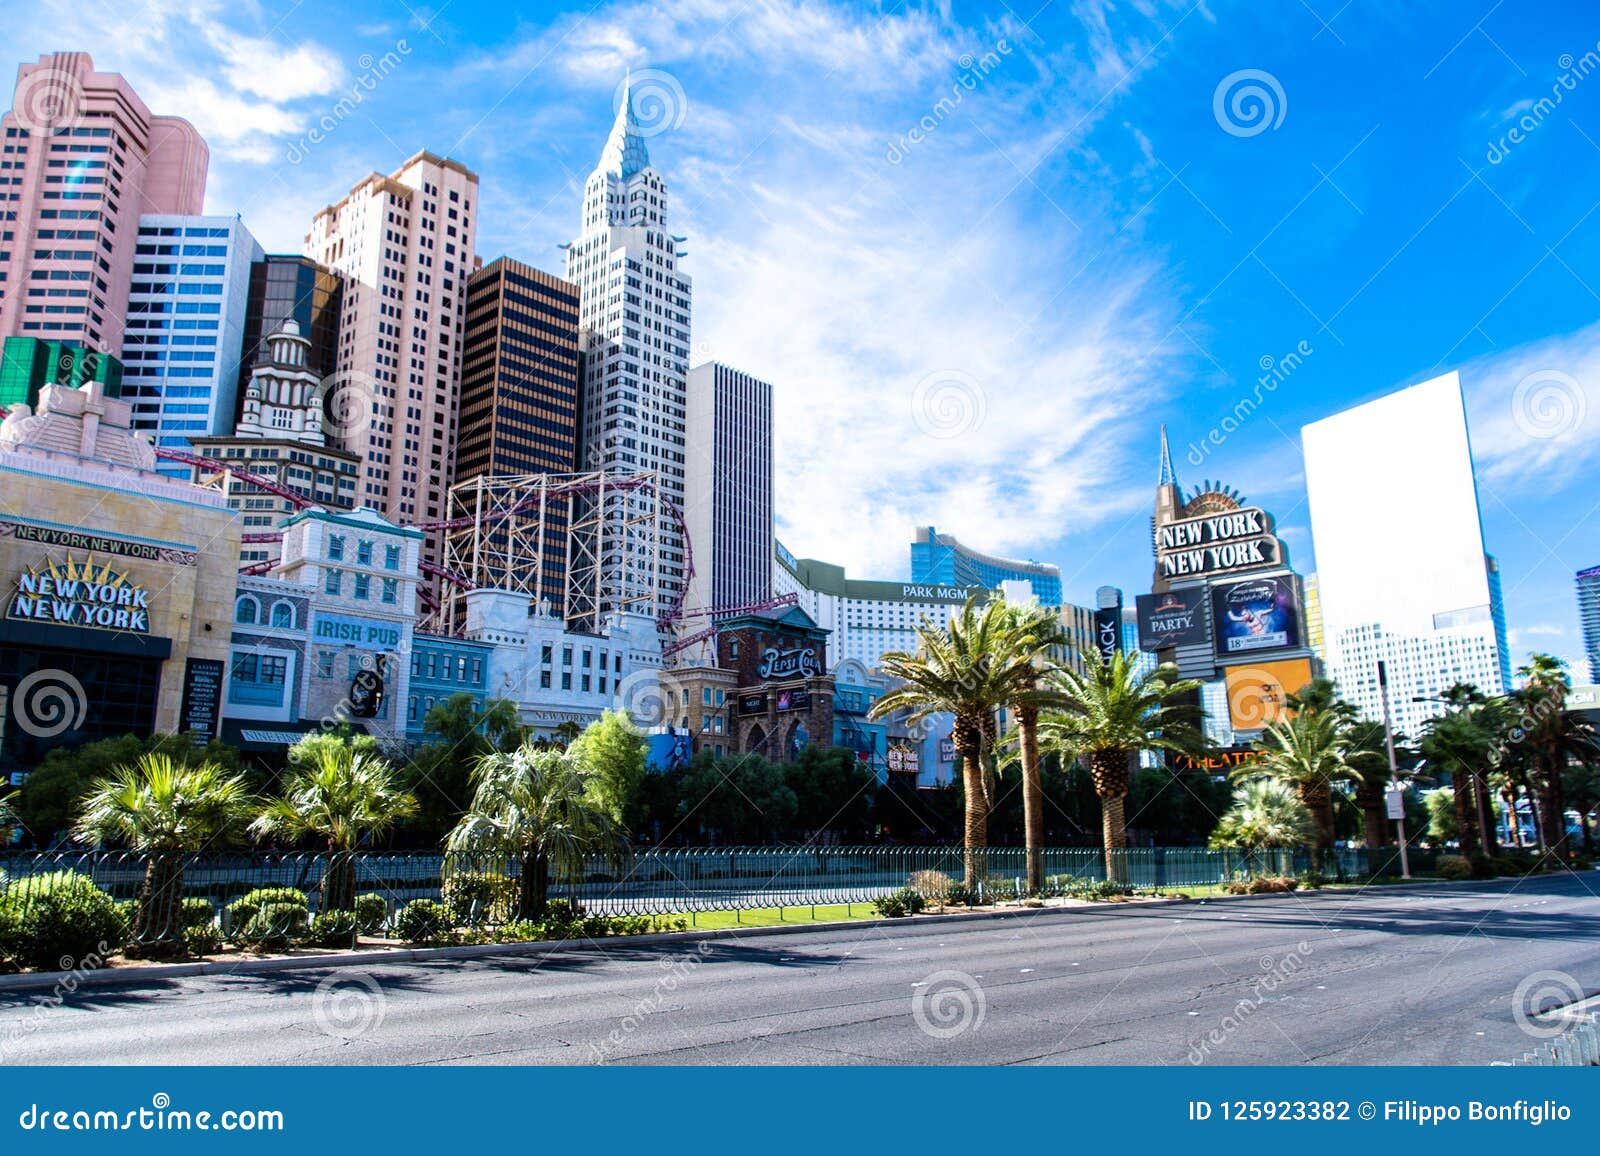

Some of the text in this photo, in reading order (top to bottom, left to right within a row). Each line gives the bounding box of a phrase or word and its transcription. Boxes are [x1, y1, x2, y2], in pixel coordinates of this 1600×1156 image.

[17, 526, 159, 559] NEW YORK NEW YORK
[1162, 511, 1262, 549] NEW YORK
[1164, 540, 1264, 576] NEW YORK
[18, 573, 149, 609] NEW YORK
[903, 585, 968, 600] PARK MGM
[15, 597, 147, 631] NEW YORK
[315, 620, 399, 645] IRISH PUB
